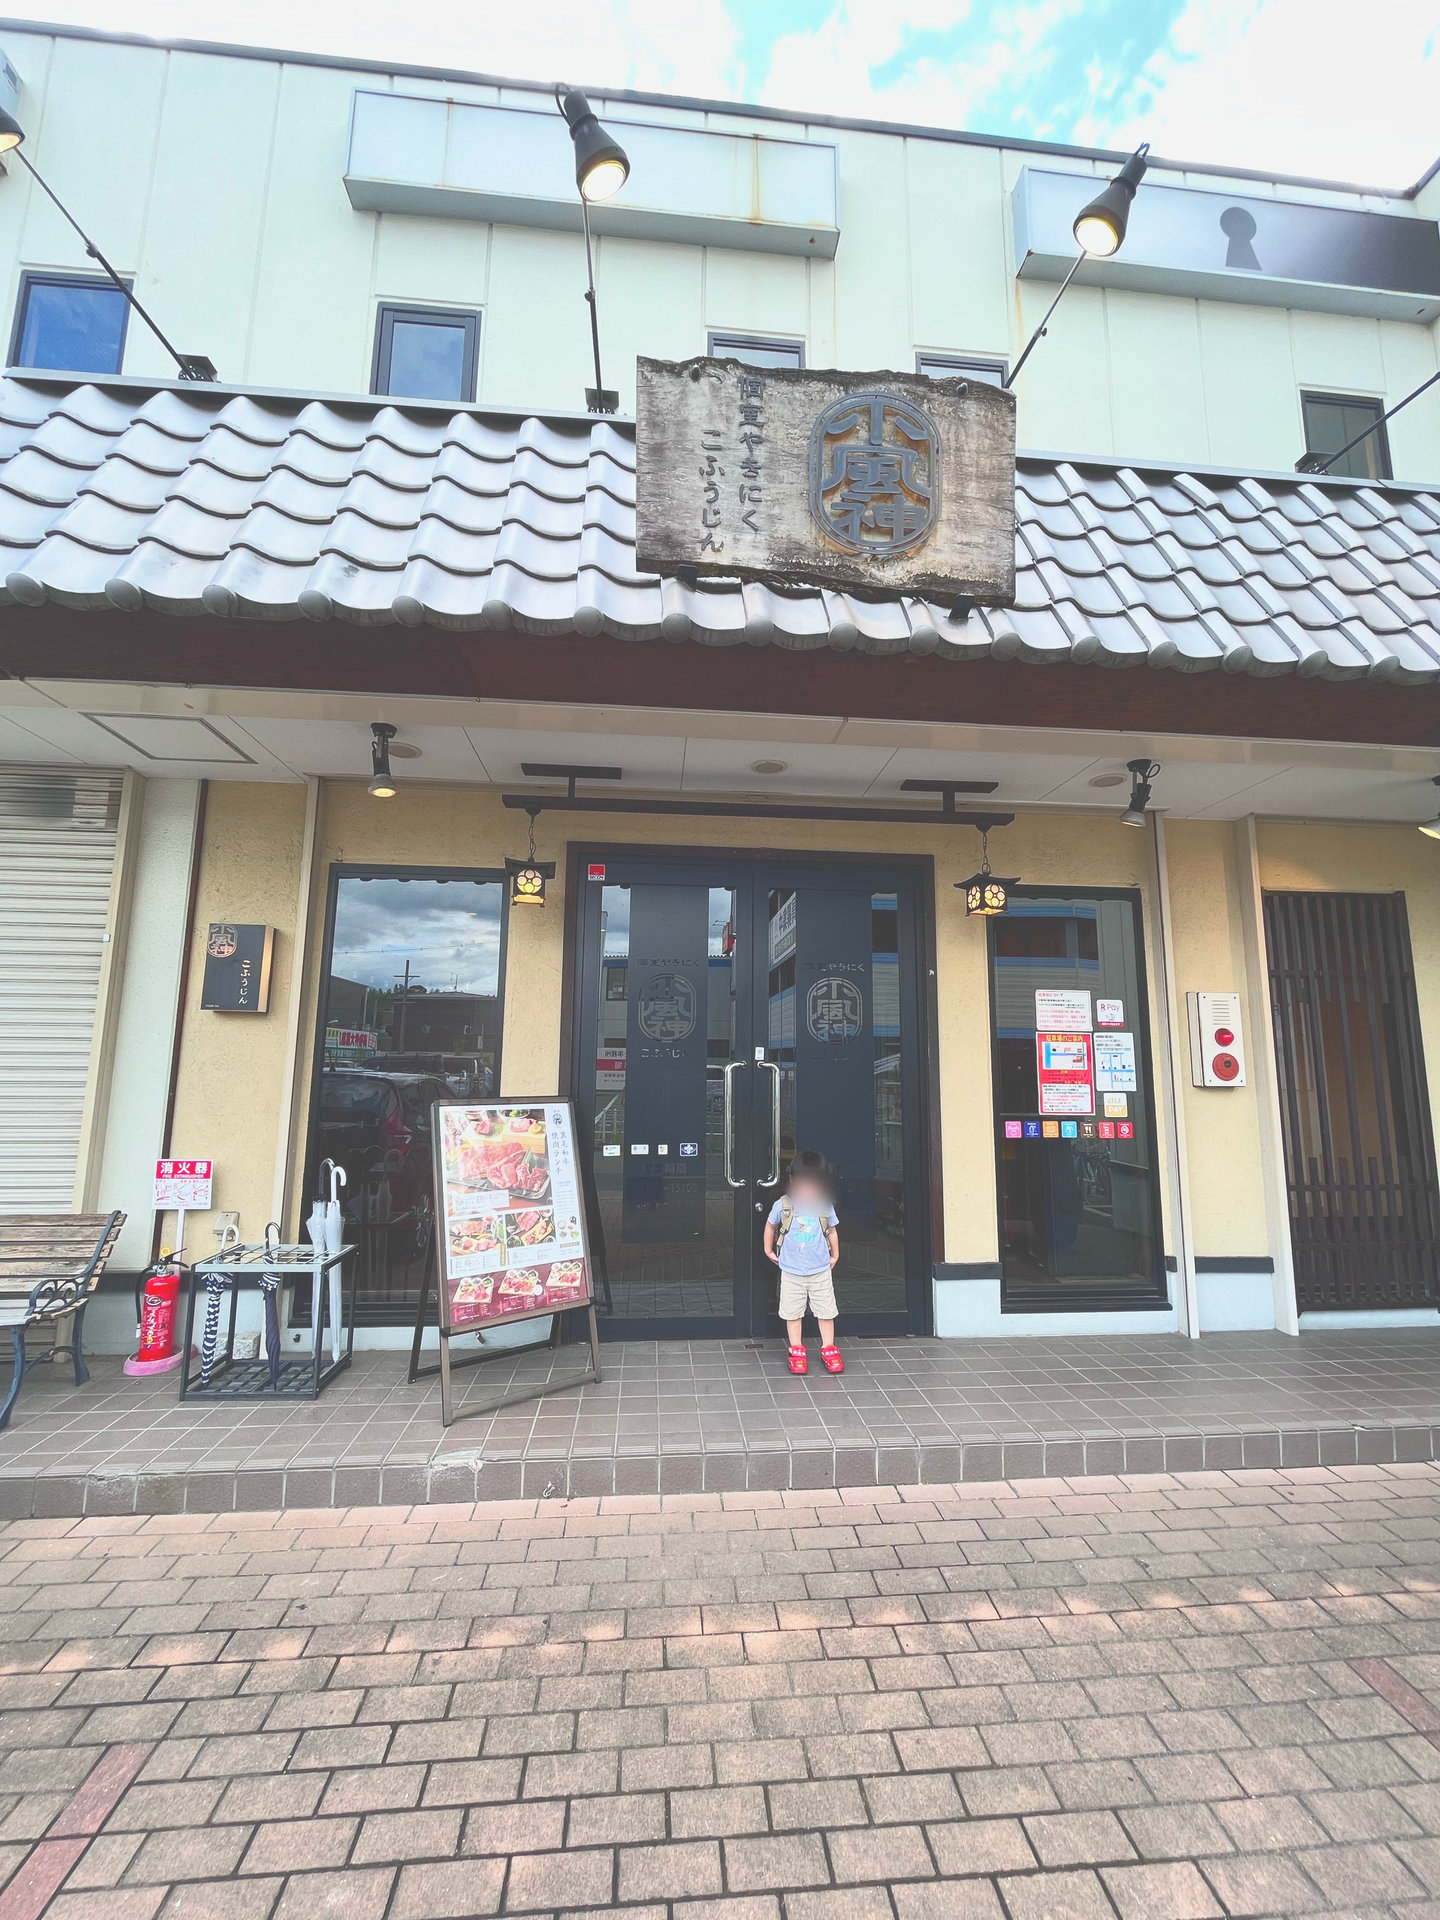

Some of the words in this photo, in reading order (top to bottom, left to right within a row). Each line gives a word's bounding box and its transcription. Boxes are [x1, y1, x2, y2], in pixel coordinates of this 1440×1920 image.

[699, 429, 725, 553] こふうじん
[738, 375, 766, 532] 個室やきにく
[818, 397, 936, 549] 小風神
[239, 960, 251, 1004] こふうじん
[1107, 1004, 1120, 1012] Pay
[160, 1161, 208, 1174] 消火器
